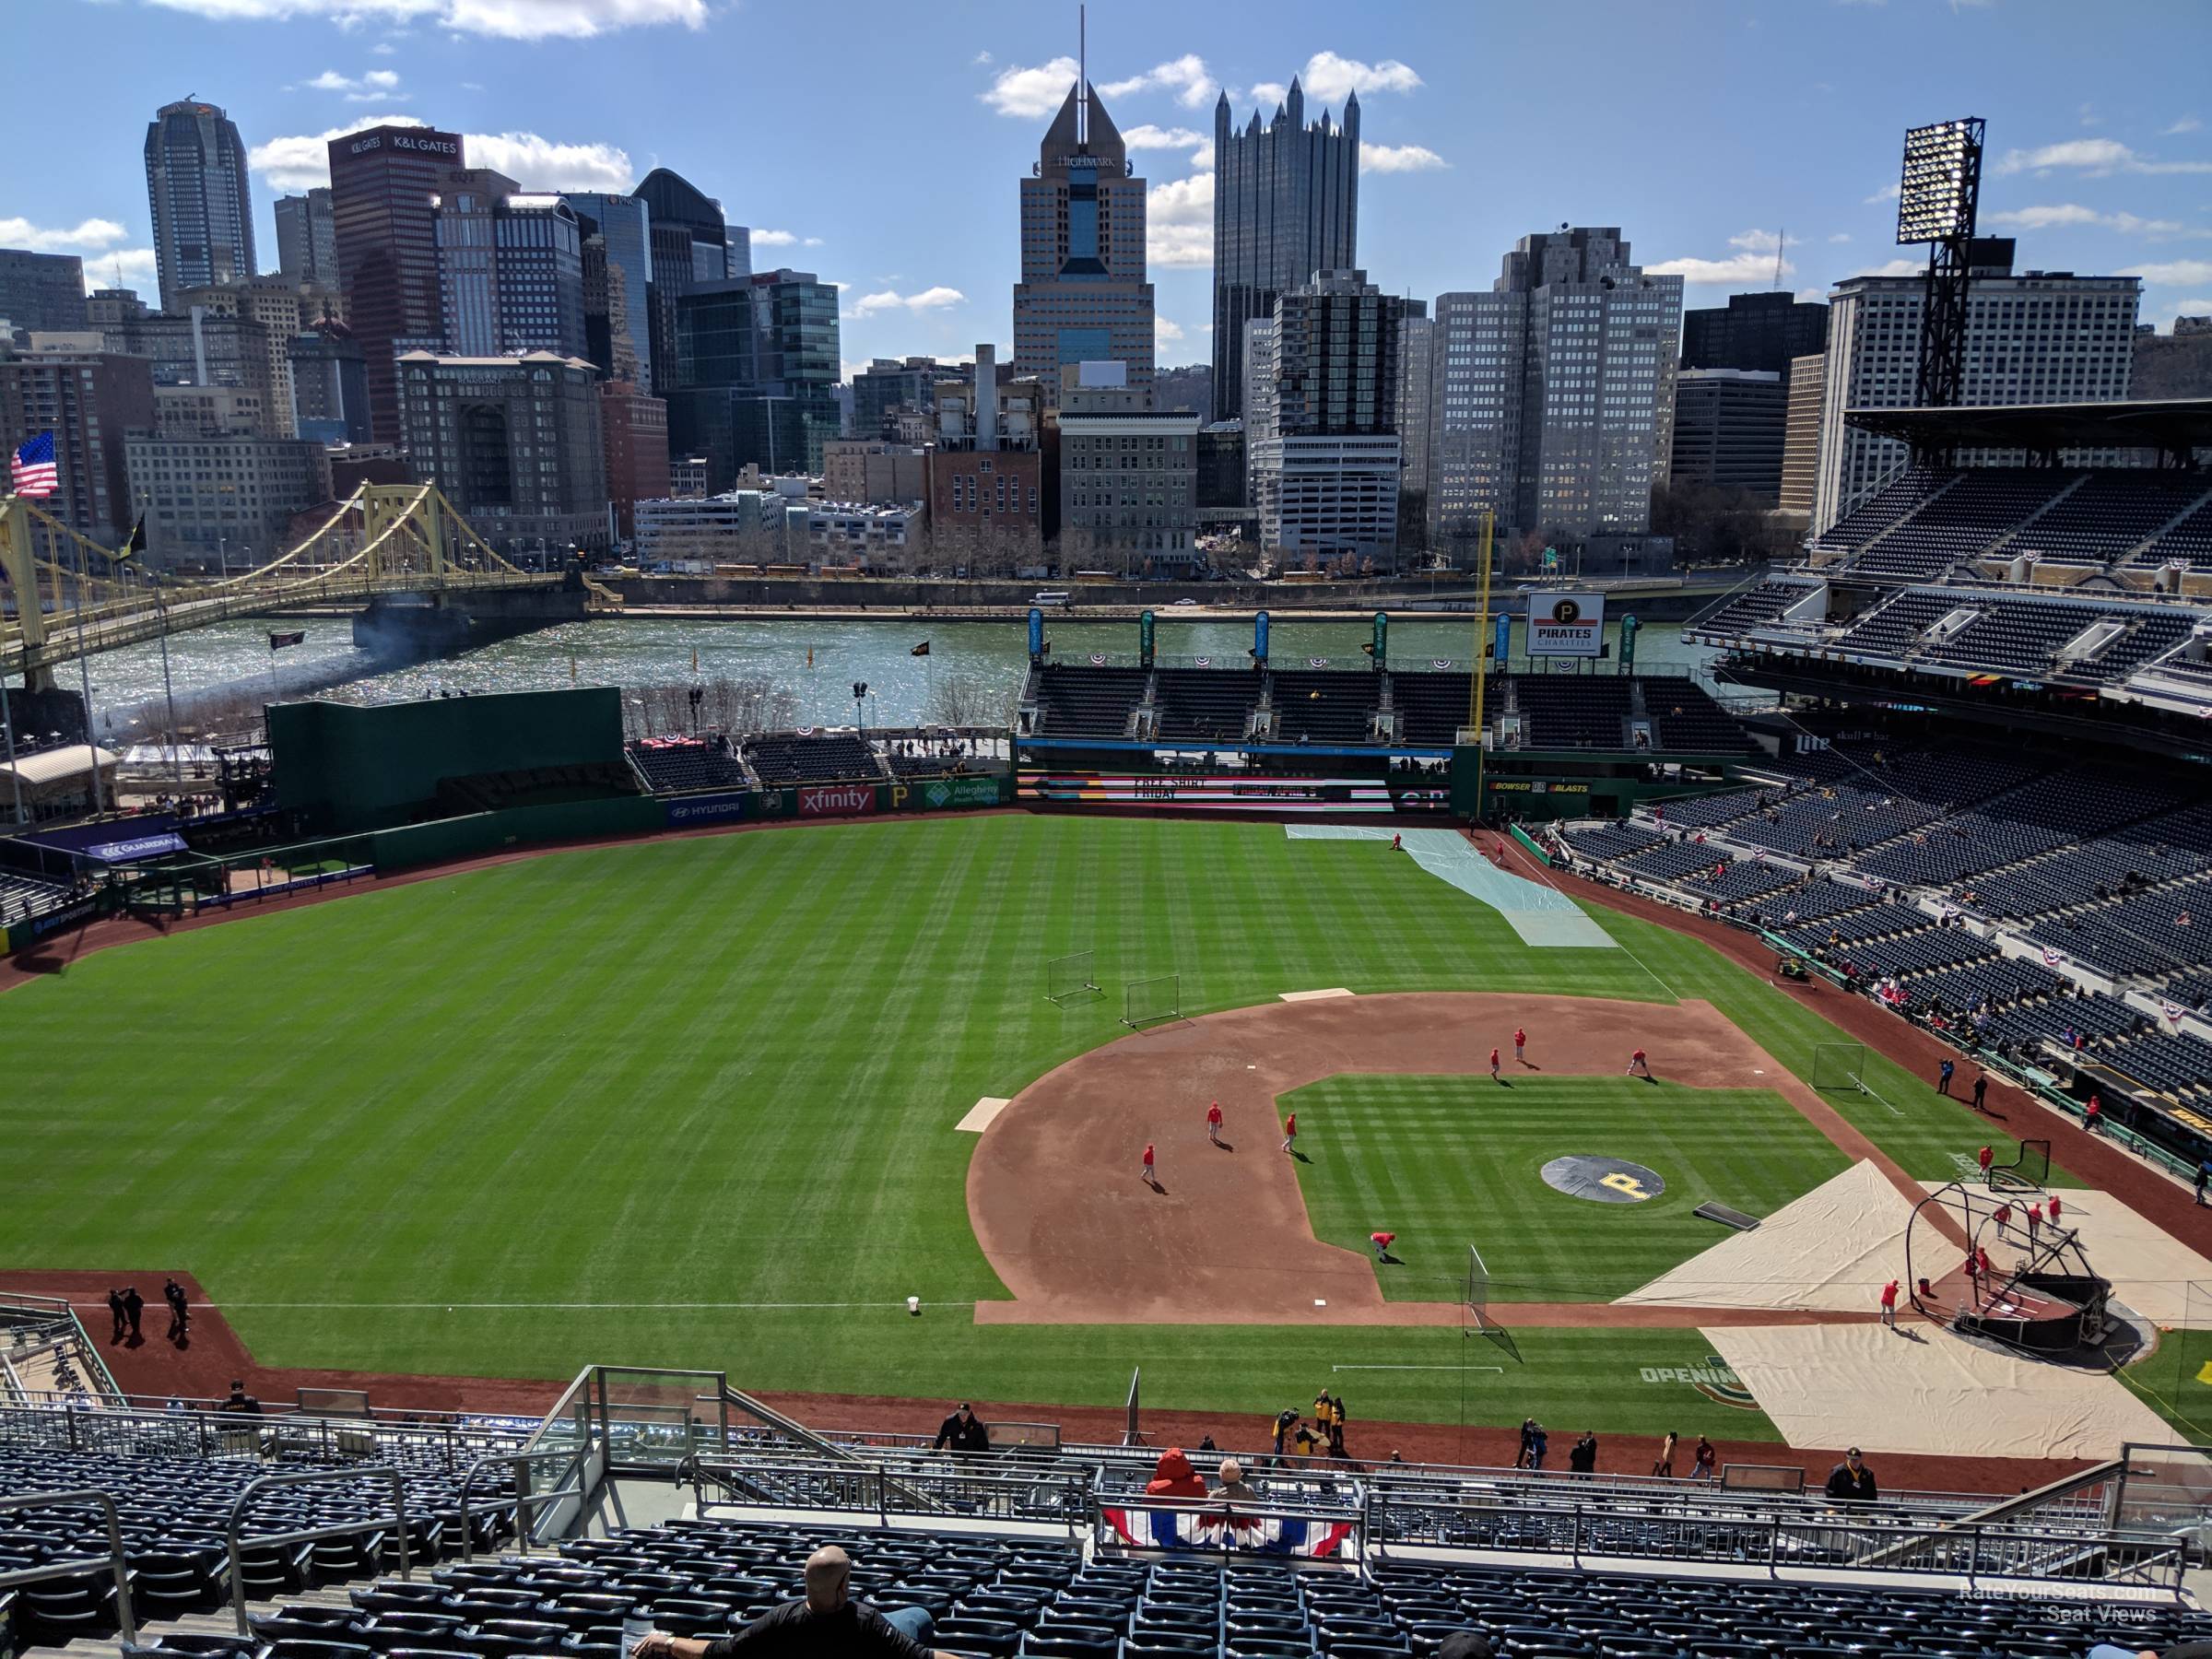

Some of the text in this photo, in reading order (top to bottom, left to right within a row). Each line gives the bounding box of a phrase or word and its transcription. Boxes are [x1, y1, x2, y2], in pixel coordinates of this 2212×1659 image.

[362, 136, 381, 150] GATES
[394, 136, 457, 154] K&L GATES
[1560, 605, 1572, 621] P
[1537, 629, 1592, 639] PIRATES
[1537, 639, 1591, 647] CHARITIES
[1794, 735, 1830, 754] Lite
[1134, 777, 1206, 788] FREE SHIRT
[1495, 782, 1531, 791] BOWSER
[1555, 784, 1589, 793] BLASTS
[891, 786, 908, 807] P
[954, 785, 998, 796] Allegheny
[1134, 789, 1177, 799] FRIDAY
[804, 789, 870, 812] xfinity
[691, 802, 739, 816] HYUNDAI
[121, 837, 181, 853] GUARDIAN
[1639, 1368, 1738, 1382] OPENIN
